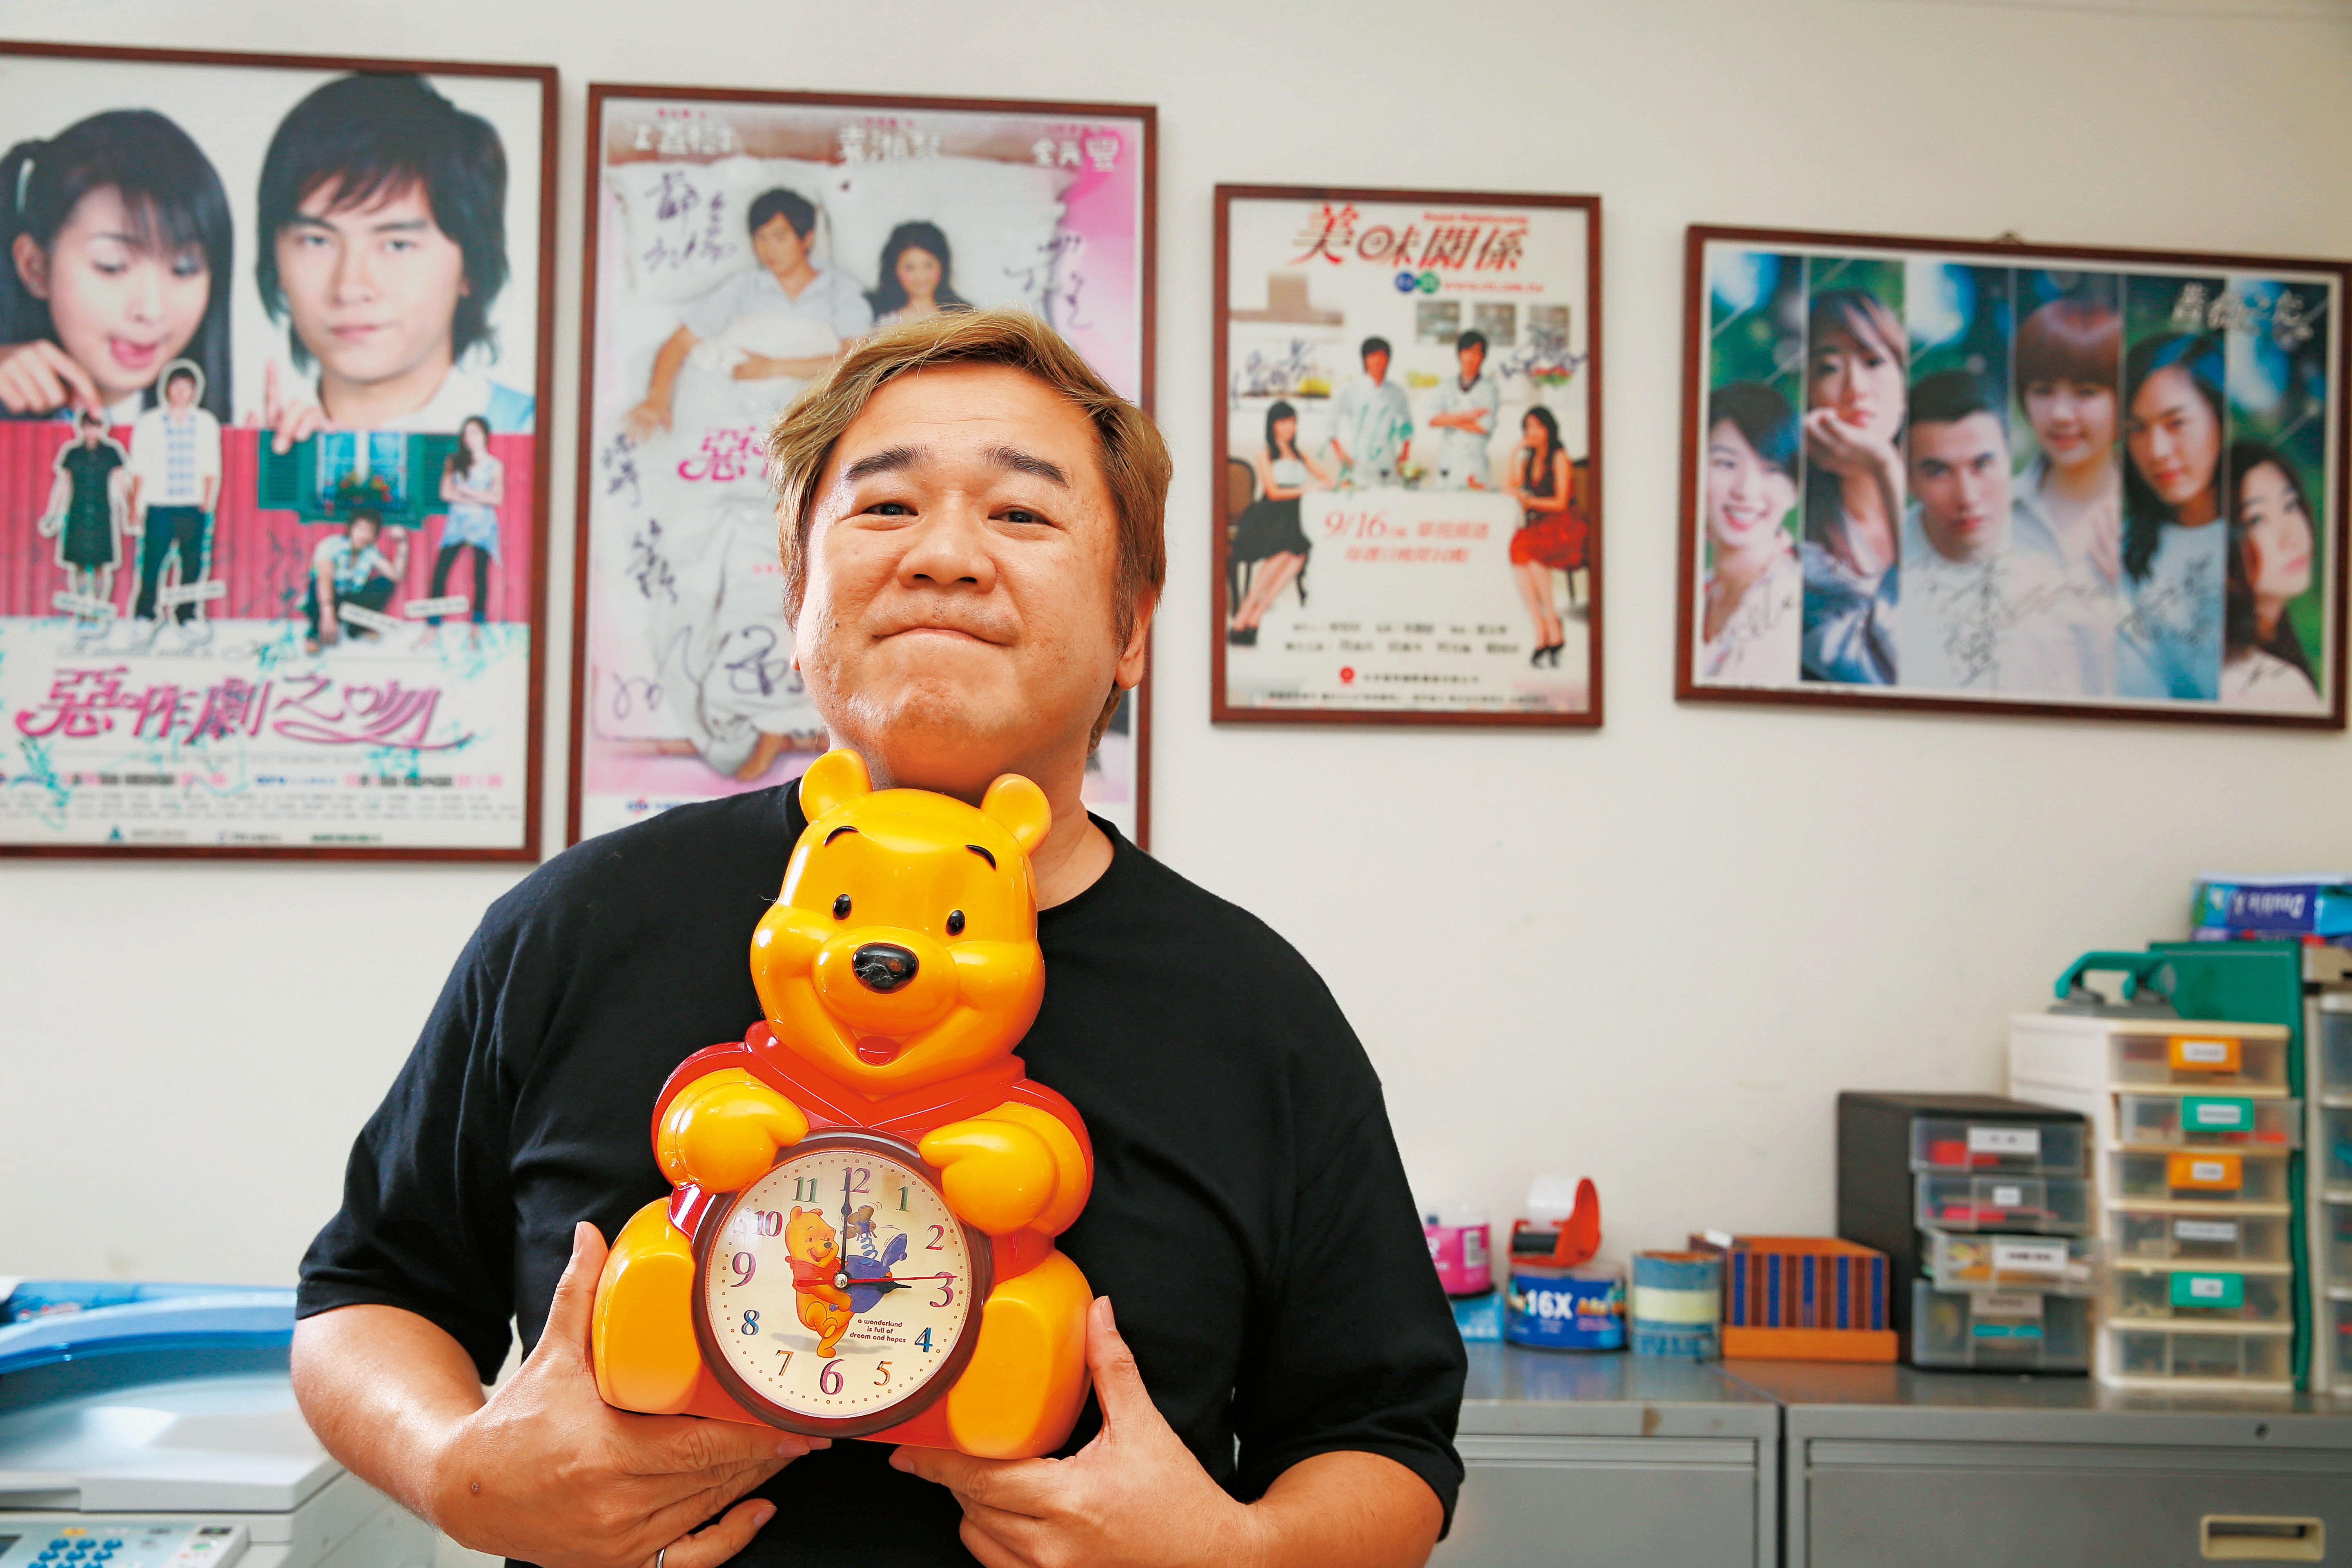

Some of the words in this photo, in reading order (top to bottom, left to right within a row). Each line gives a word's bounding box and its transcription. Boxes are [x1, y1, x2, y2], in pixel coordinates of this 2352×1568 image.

[1289, 204, 1528, 272] 美味關係
[677, 425, 770, 482] 惡
[1324, 509, 1388, 538] 9/16
[14, 664, 474, 750] 惡作劇之吻
[791, 1176, 819, 1203] 11
[840, 1167, 871, 1194] 12
[896, 1186, 910, 1212] 1
[751, 1210, 782, 1237] 10
[925, 1225, 944, 1250] 2
[731, 1252, 756, 1287] 9
[930, 1272, 954, 1307] 3
[1527, 1289, 1573, 1320] 16X
[741, 1310, 760, 1335] 8
[914, 1327, 933, 1353] 4
[775, 1350, 794, 1376] 7
[873, 1361, 893, 1386] 5
[820, 1359, 845, 1395] 6
